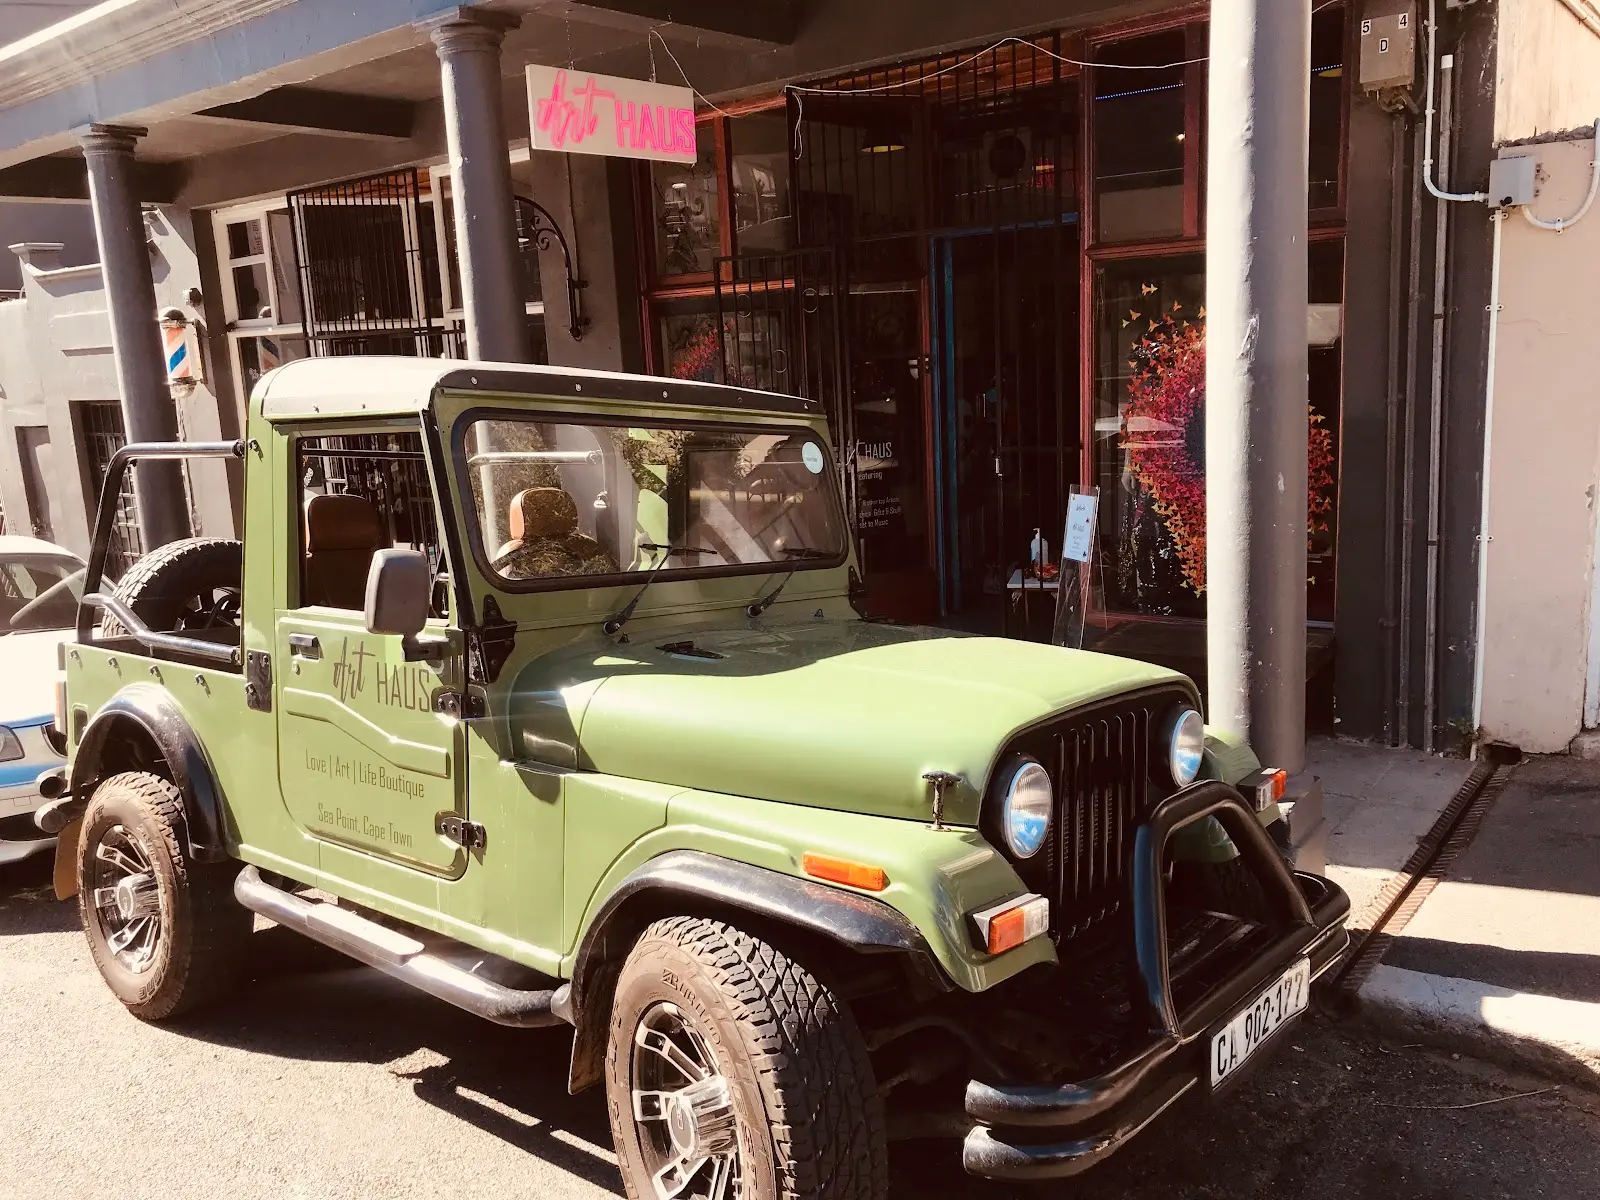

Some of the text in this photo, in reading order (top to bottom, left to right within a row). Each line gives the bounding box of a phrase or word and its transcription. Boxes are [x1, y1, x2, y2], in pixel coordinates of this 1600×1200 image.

[1362, 14, 1407, 33] 5 4
[1380, 39, 1388, 52] D
[536, 70, 696, 155] Art HAUS
[865, 442, 892, 459] HAUS
[333, 637, 431, 713] Art HAUS
[305, 749, 327, 773] Love
[335, 756, 350, 779] Art
[359, 761, 377, 786] Life
[379, 767, 425, 799] Boutique
[318, 803, 334, 823] Sea
[363, 816, 386, 840] Cape
[388, 823, 413, 848] Town
[1217, 1027, 1238, 1076] CA
